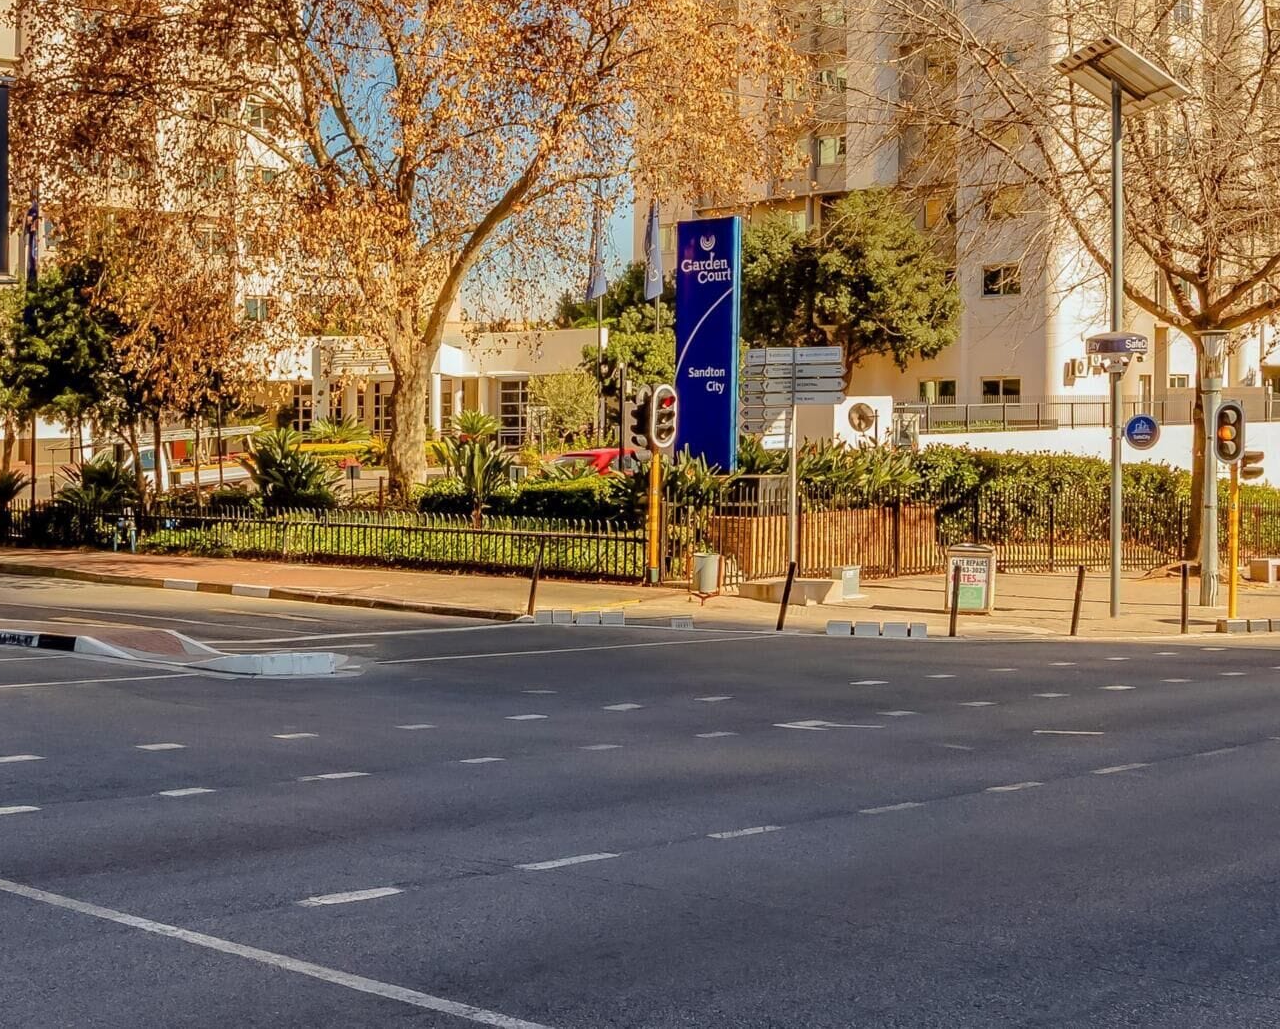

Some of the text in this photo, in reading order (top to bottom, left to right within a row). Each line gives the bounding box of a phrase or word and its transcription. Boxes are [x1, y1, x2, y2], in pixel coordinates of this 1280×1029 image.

[680, 251, 728, 273] Garden
[697, 267, 732, 284] Court
[688, 366, 726, 378] Sandton
[706, 381, 725, 395] City
[966, 559, 988, 567] REPAIRS
